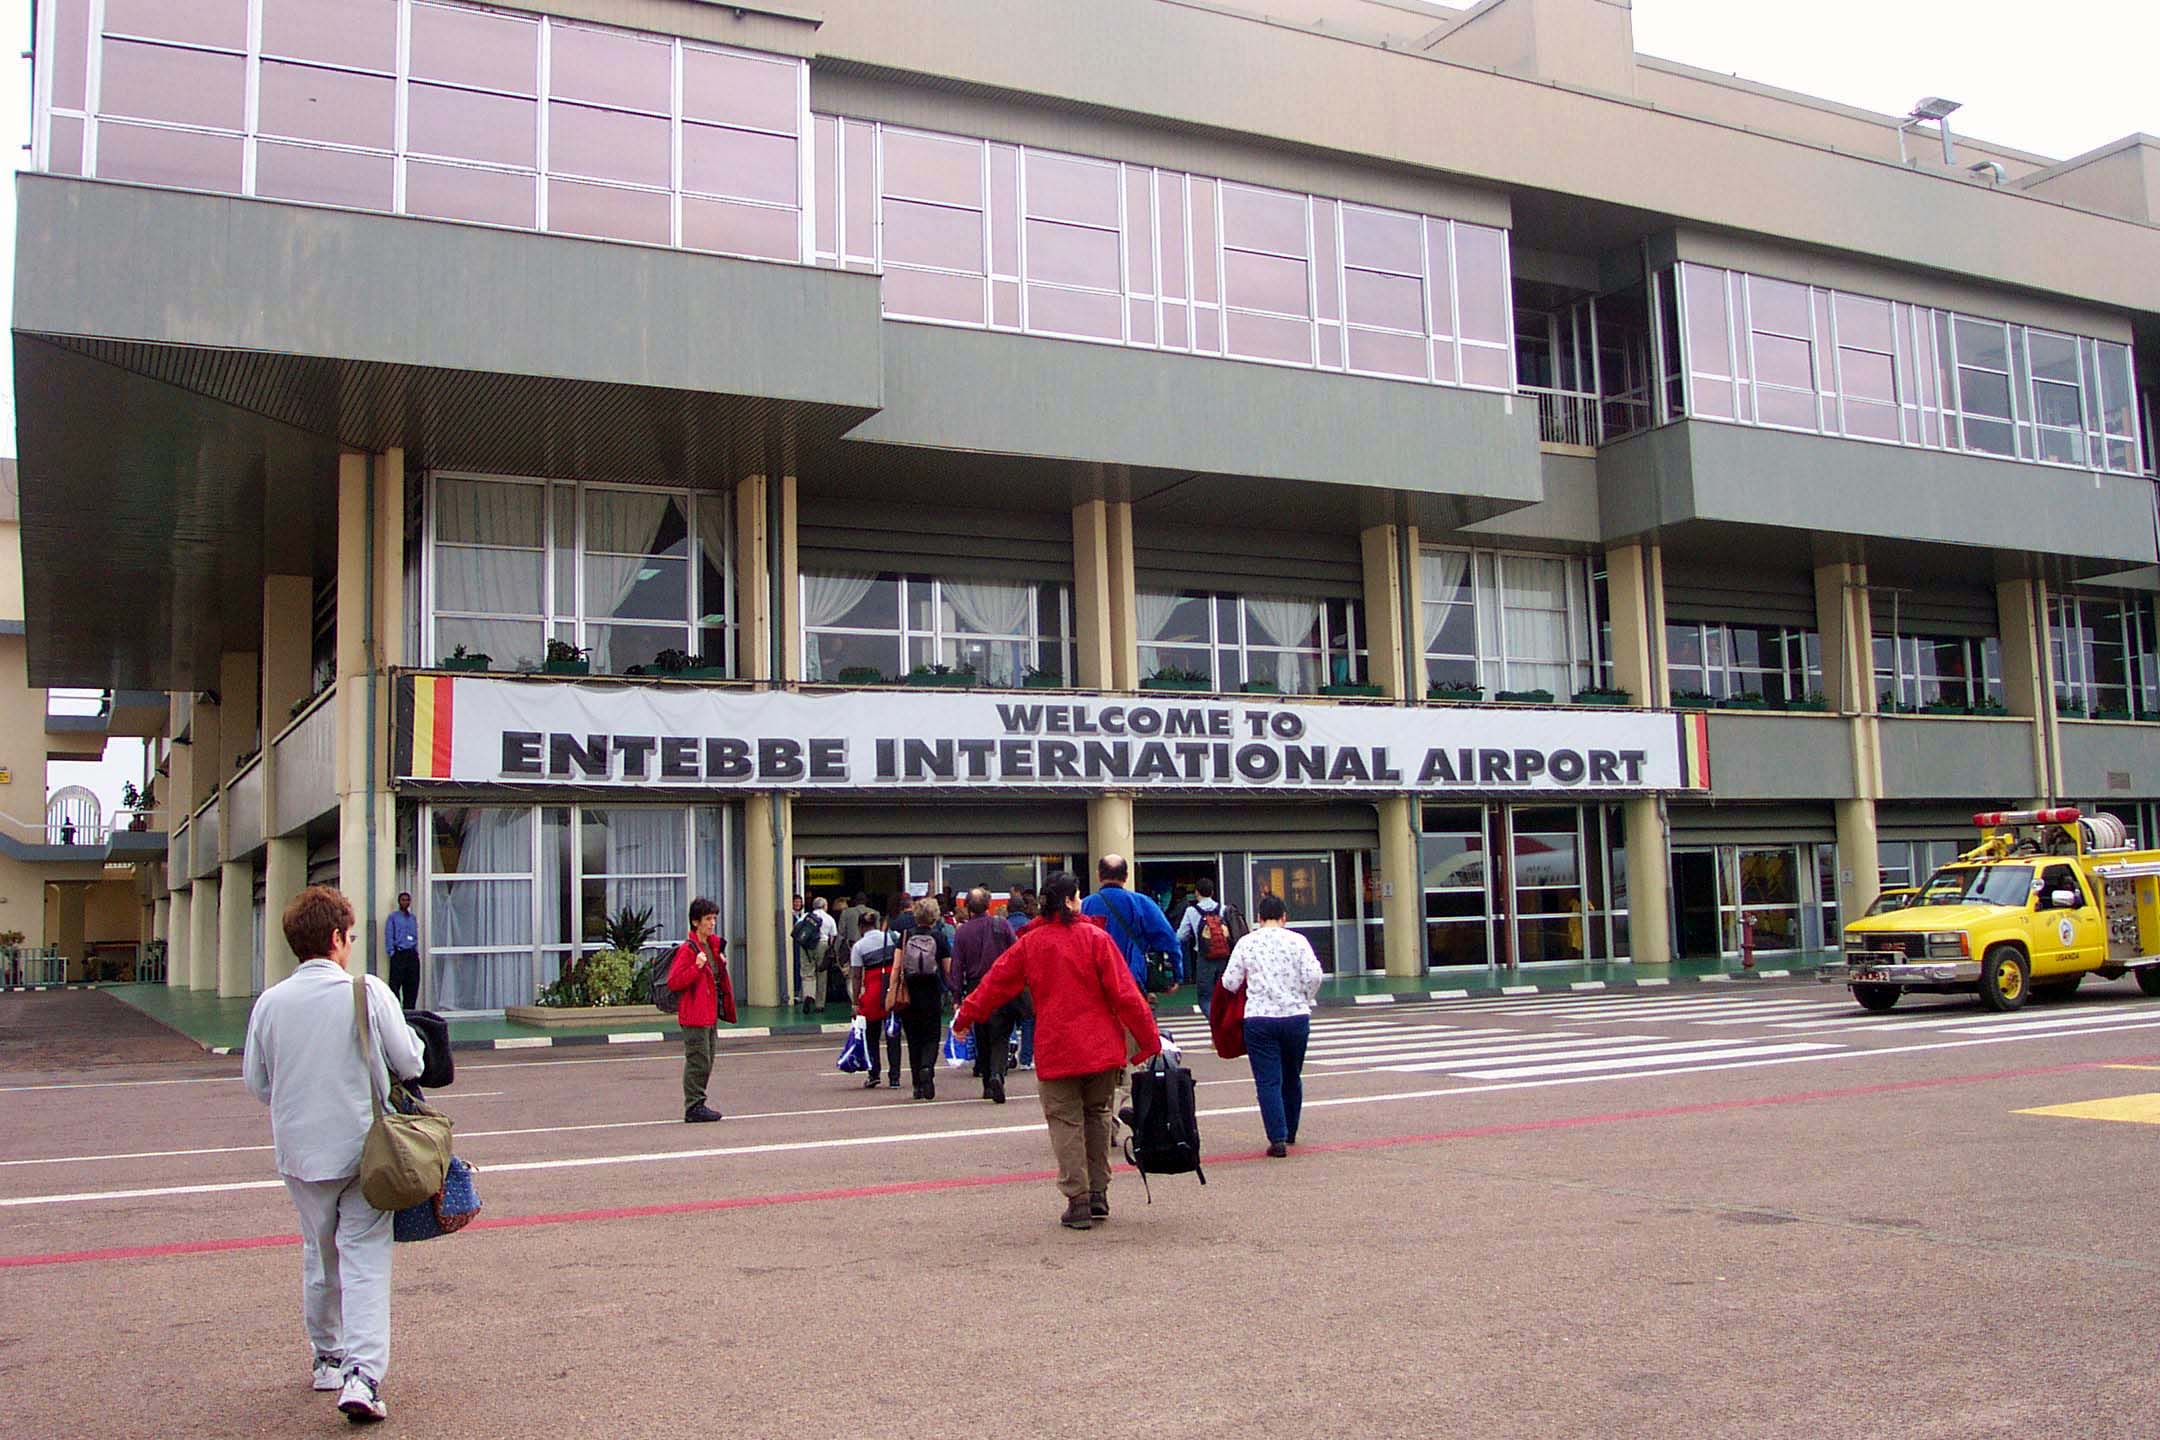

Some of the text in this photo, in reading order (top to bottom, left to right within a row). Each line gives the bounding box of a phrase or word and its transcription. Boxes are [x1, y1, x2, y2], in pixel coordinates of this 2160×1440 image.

[996, 704, 1306, 740] WELCOME TO
[498, 731, 1648, 786] ENTEBBE INTERNATIONAL AIRPORT
